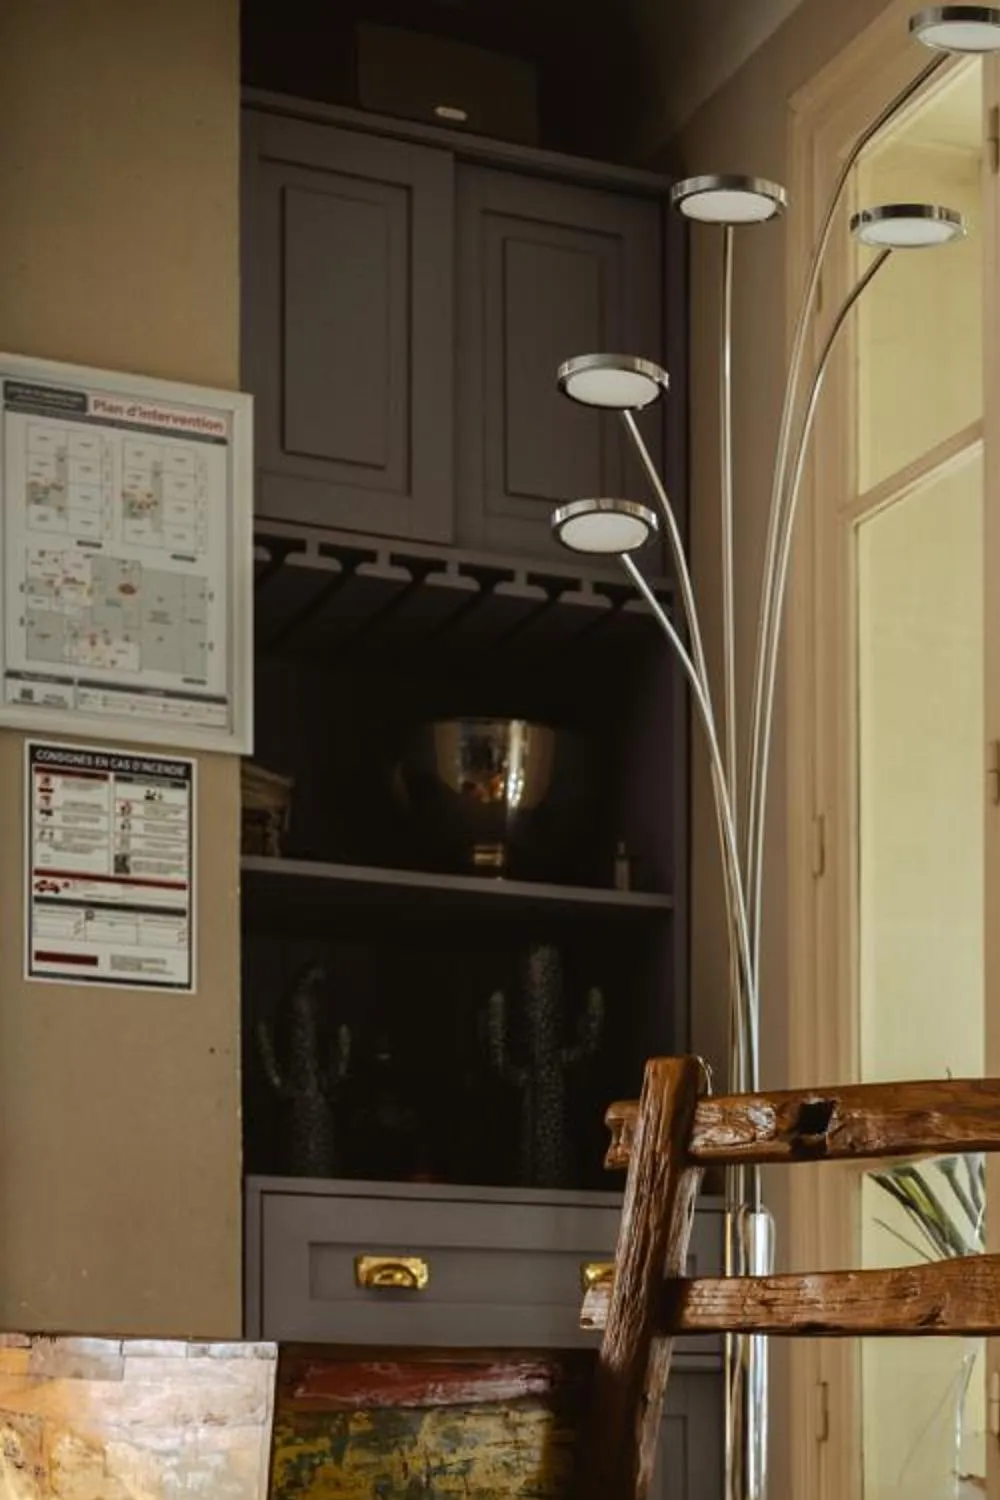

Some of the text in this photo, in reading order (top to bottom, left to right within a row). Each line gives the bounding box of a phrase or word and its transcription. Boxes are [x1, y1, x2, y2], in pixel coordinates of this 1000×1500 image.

[93, 399, 224, 432] Plan d'intervention
[36, 749, 93, 766] CONSIGNES
[95, 756, 109, 768] EN
[111, 758, 131, 770] CAS
